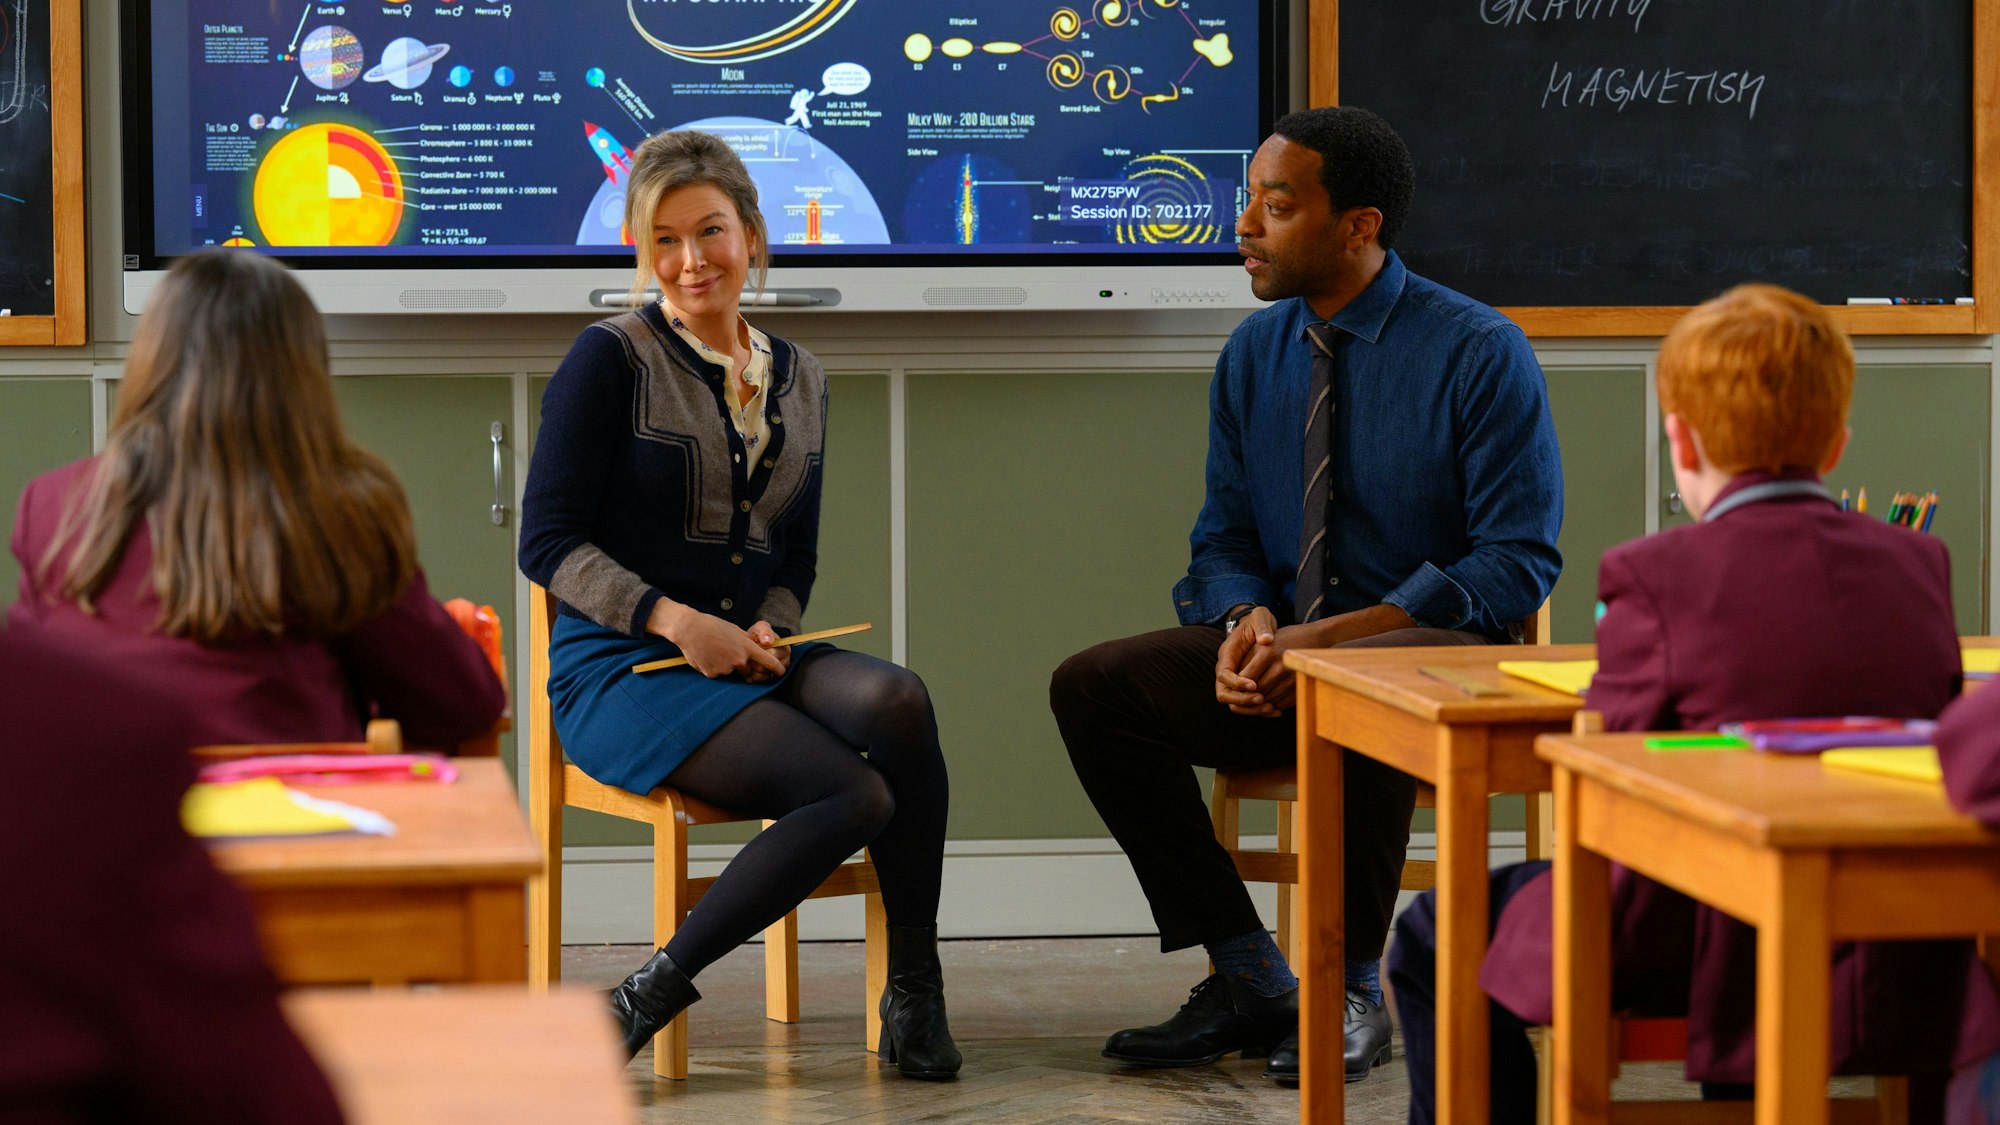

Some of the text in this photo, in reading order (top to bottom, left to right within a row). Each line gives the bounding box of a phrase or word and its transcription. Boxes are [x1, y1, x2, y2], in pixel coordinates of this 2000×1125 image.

[475, 8, 501, 16] Mercury
[1541, 63, 1766, 119] MAGNETISM
[316, 94, 338, 102] Jupiter
[485, 94, 513, 102] Neptune
[1082, 105, 1100, 113] Spiral
[837, 119, 870, 127] Armstrong
[960, 112, 977, 126] 200
[420, 155, 460, 163] Photosphere
[1070, 186, 1140, 198] MX275PW
[1071, 205, 1128, 218] Session
[1132, 205, 1151, 218] ID:
[1155, 205, 1212, 218] 702177
